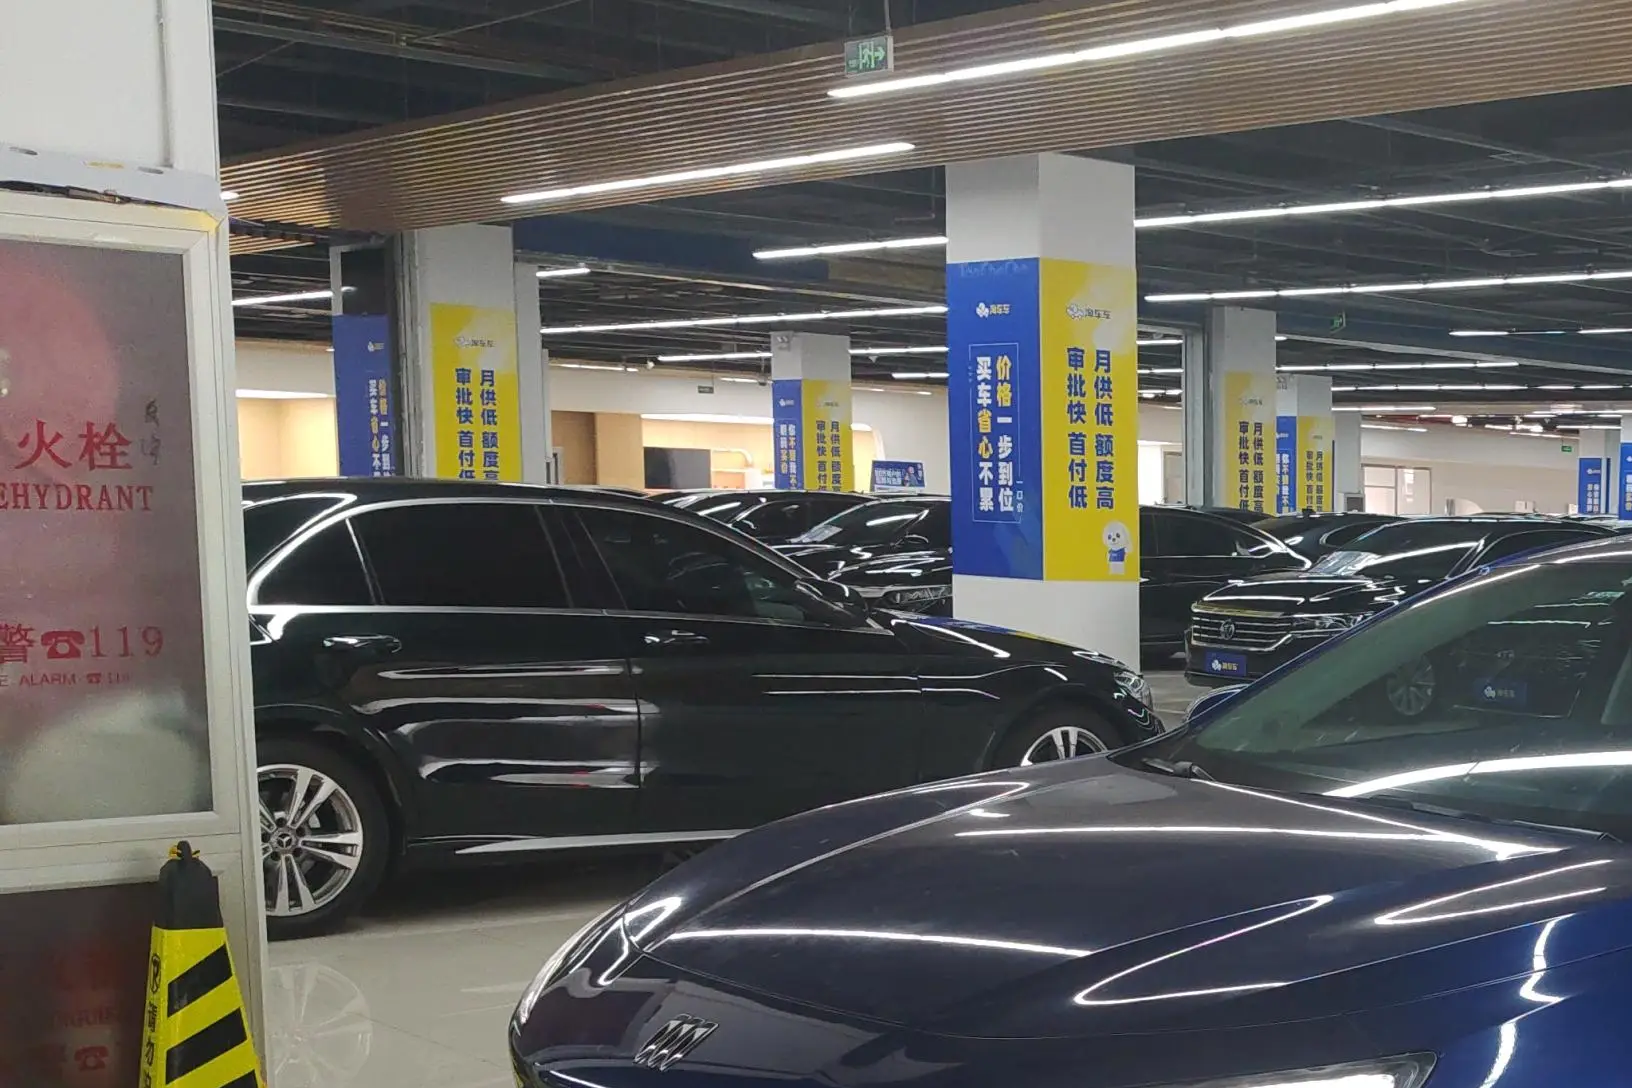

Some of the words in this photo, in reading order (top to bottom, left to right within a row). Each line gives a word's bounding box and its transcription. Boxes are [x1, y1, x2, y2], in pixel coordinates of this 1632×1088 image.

[14, 418, 133, 471] 火栓
[976, 356, 994, 512] 买车省心不累
[996, 355, 1014, 512] 价格一步到位
[1066, 347, 1087, 509] 审批快首付低
[1093, 349, 1115, 510] 月供低额度高
[19, 672, 77, 687] ALARM
[89, 625, 164, 658] 119
